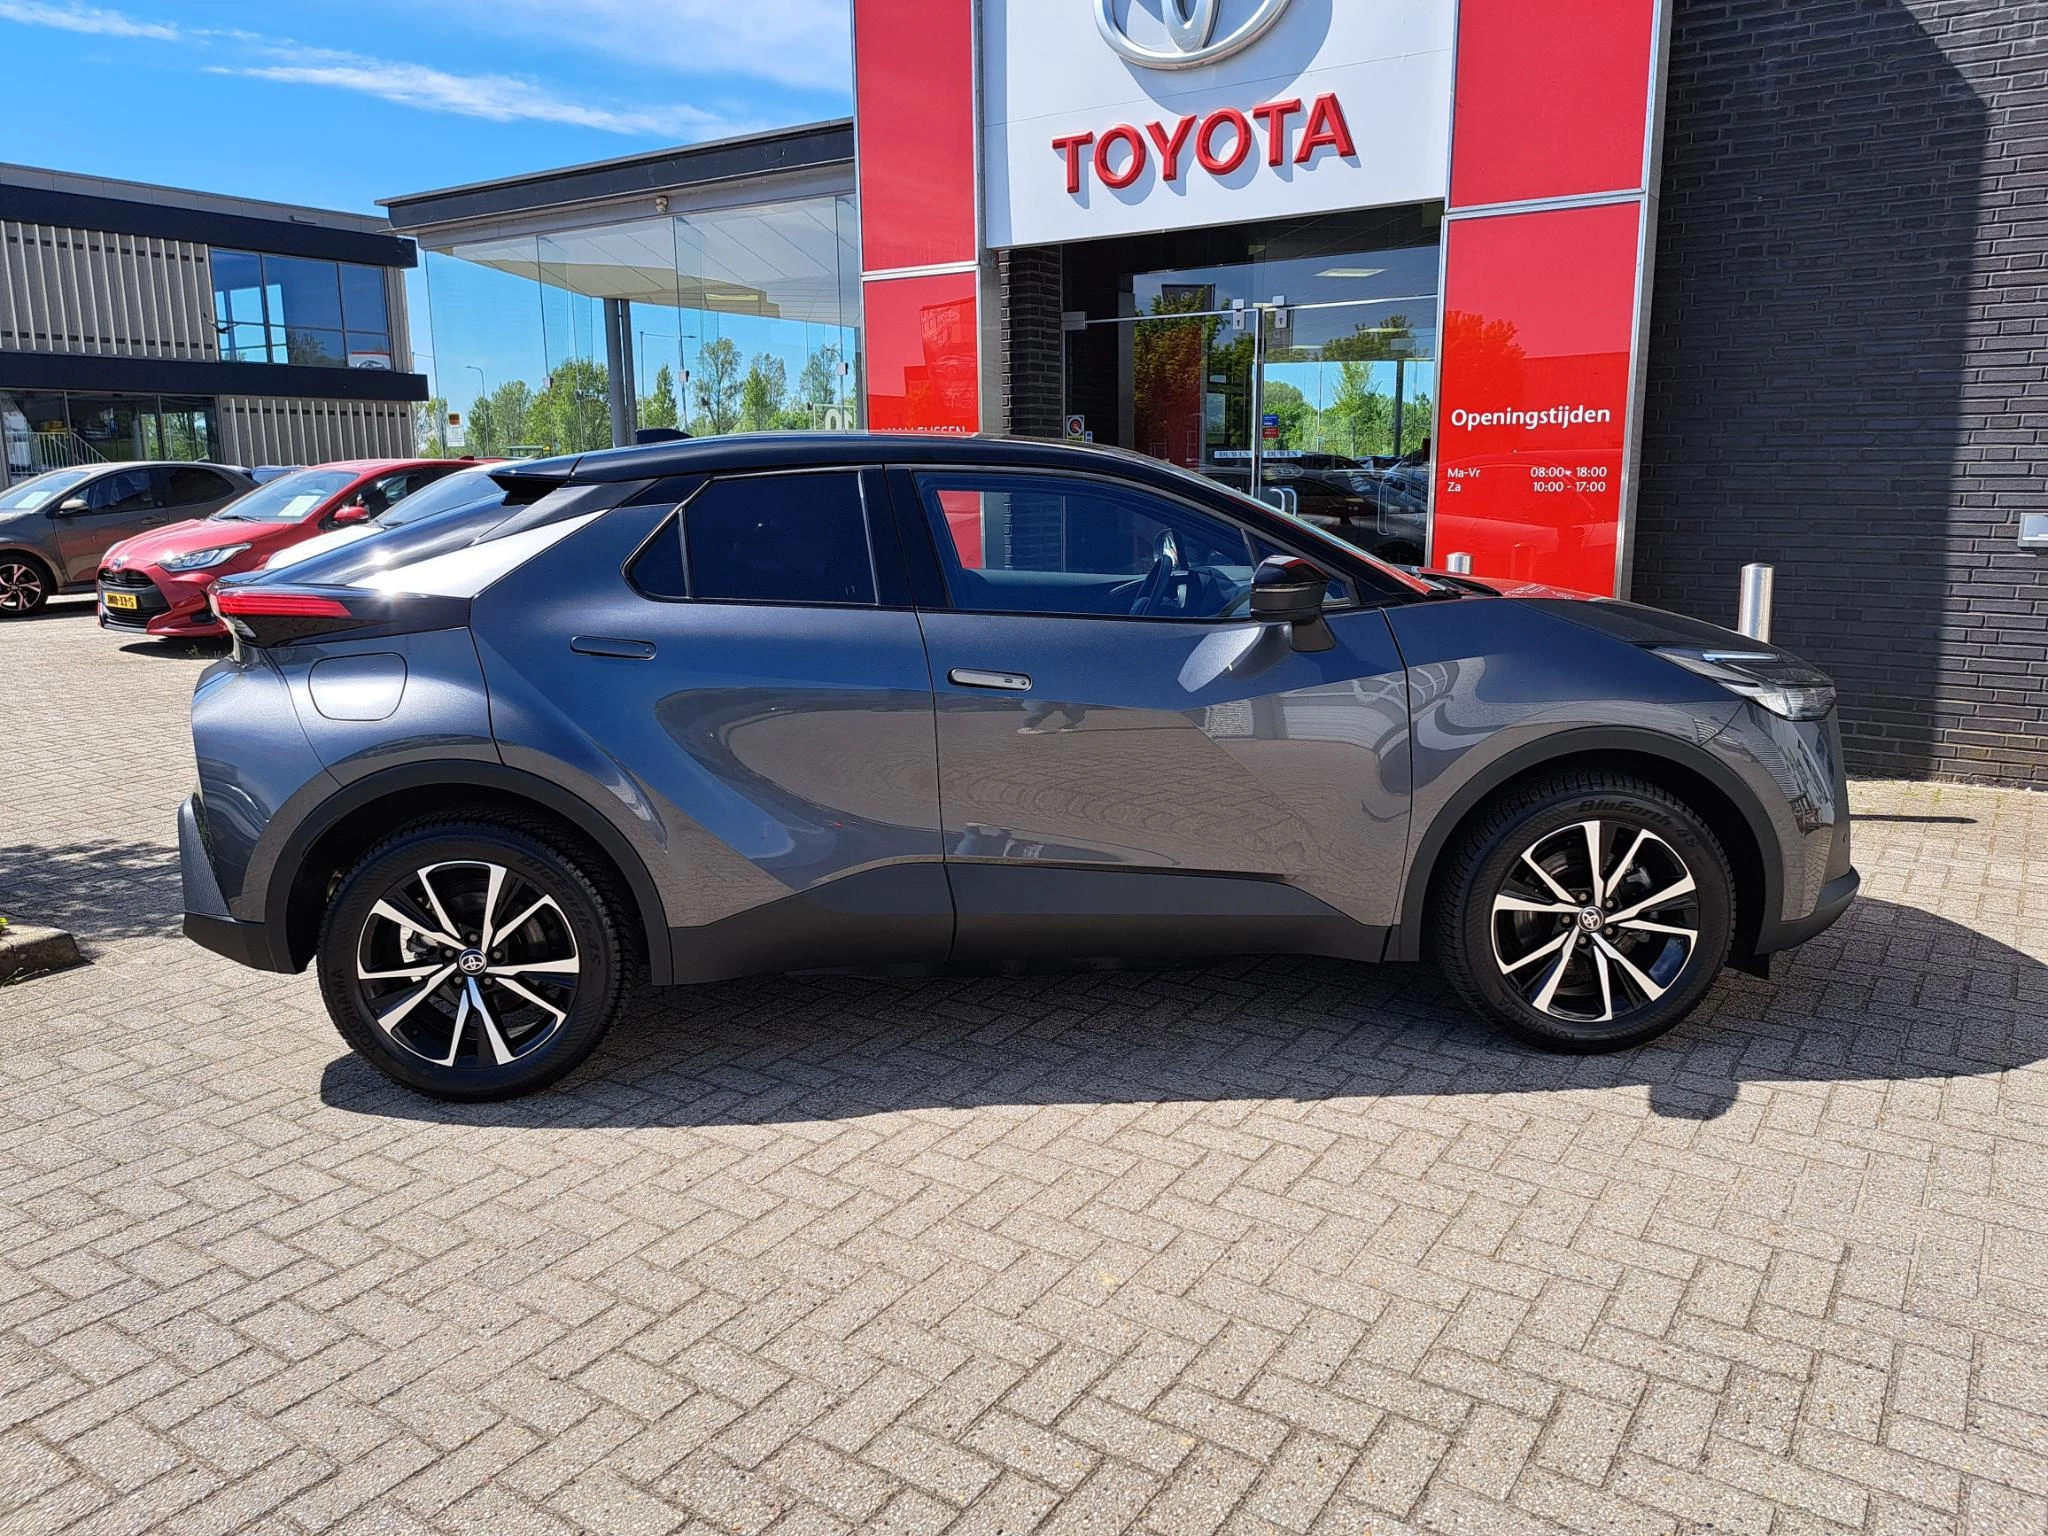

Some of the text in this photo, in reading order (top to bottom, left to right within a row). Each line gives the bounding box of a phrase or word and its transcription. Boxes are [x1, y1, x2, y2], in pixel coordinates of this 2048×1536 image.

[1052, 92, 1356, 193] TOYOTA
[1450, 405, 1611, 431] Openingstijden
[1447, 467, 1481, 478] Ma-Vr
[1530, 467, 1564, 478] 08:00
[1576, 467, 1607, 478] 18:00
[1447, 482, 1461, 492] Za
[1533, 482, 1564, 492] 10:00
[1576, 482, 1606, 492] 17:00
